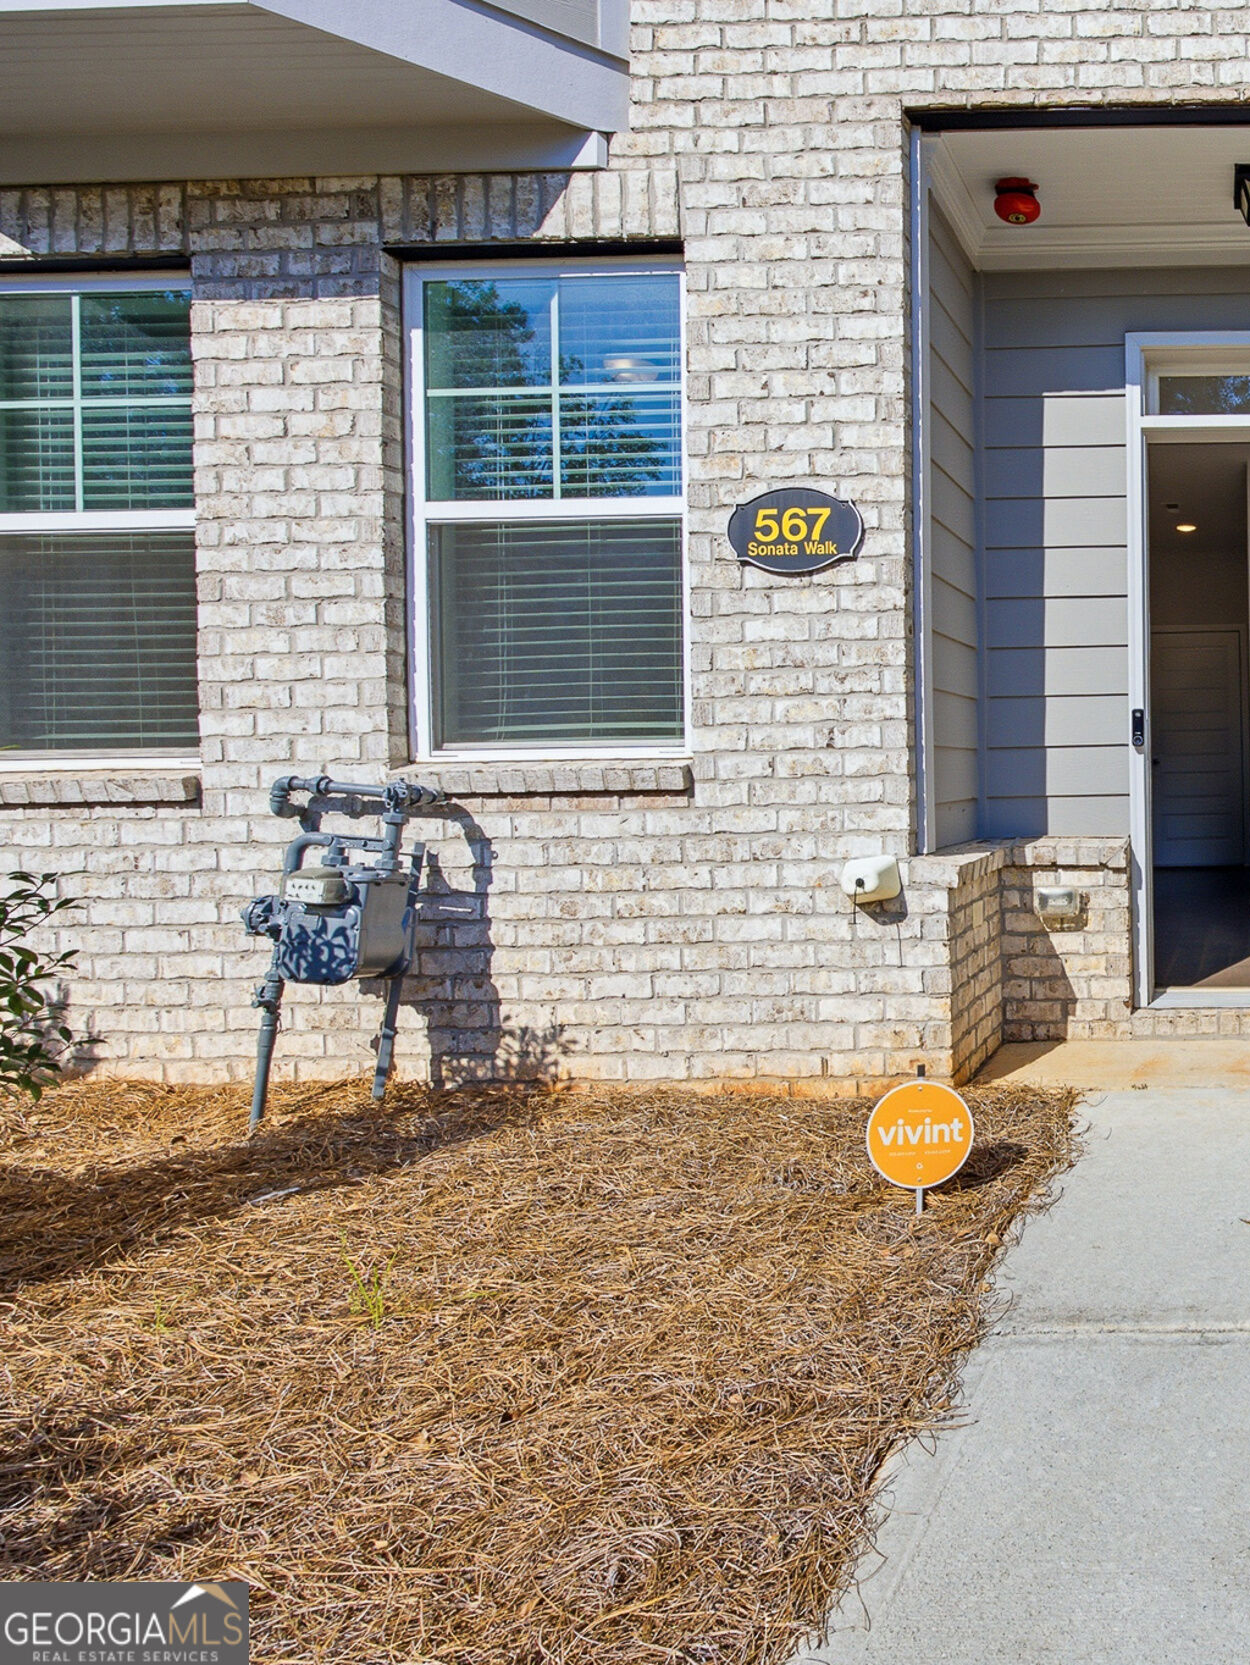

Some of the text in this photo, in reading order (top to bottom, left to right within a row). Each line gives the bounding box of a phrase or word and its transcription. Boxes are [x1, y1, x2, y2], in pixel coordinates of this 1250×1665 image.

[754, 507, 831, 542] 567
[748, 541, 838, 556] Sonata Walk
[877, 1117, 964, 1146] vivint
